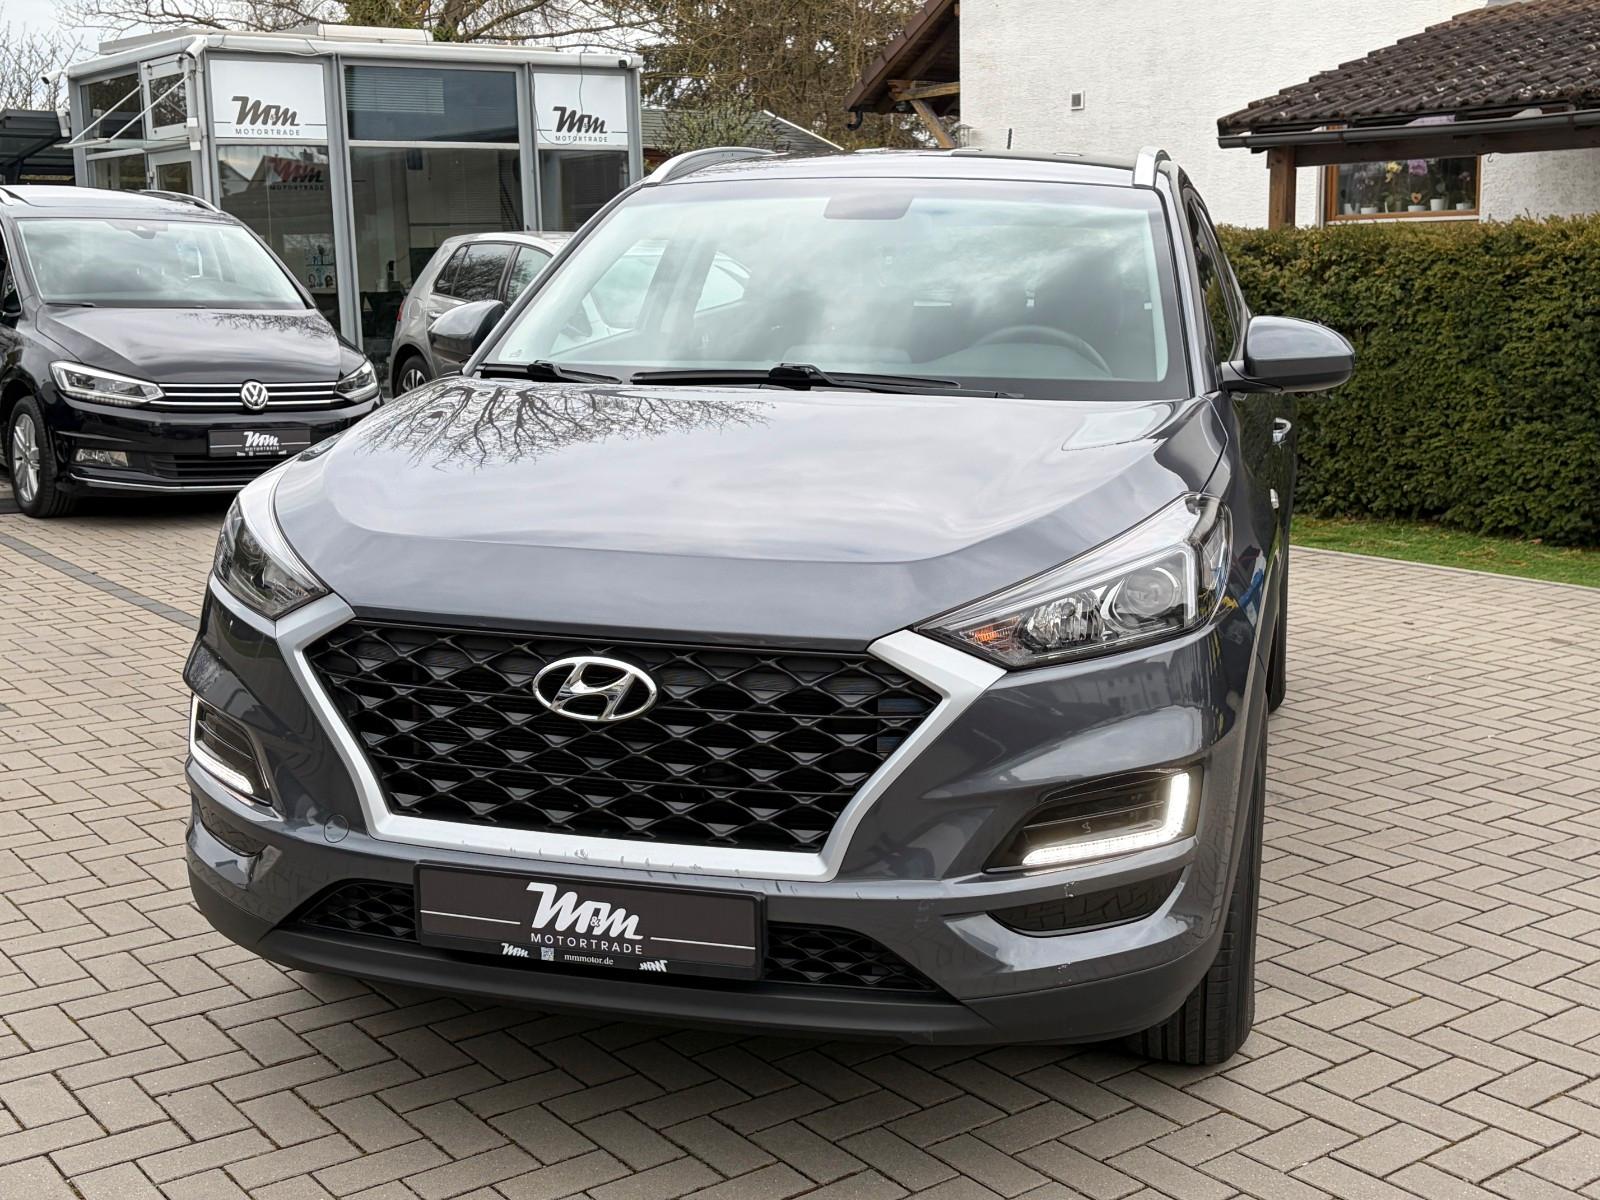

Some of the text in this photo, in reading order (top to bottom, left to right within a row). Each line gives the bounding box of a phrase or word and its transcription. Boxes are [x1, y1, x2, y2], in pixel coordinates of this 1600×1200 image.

[235, 128, 300, 136] MOTORTRADE
[555, 135, 608, 143] MOTORTRADE
[530, 932, 643, 955] MOTORTRADE
[564, 953, 614, 966] mmmotor.de
